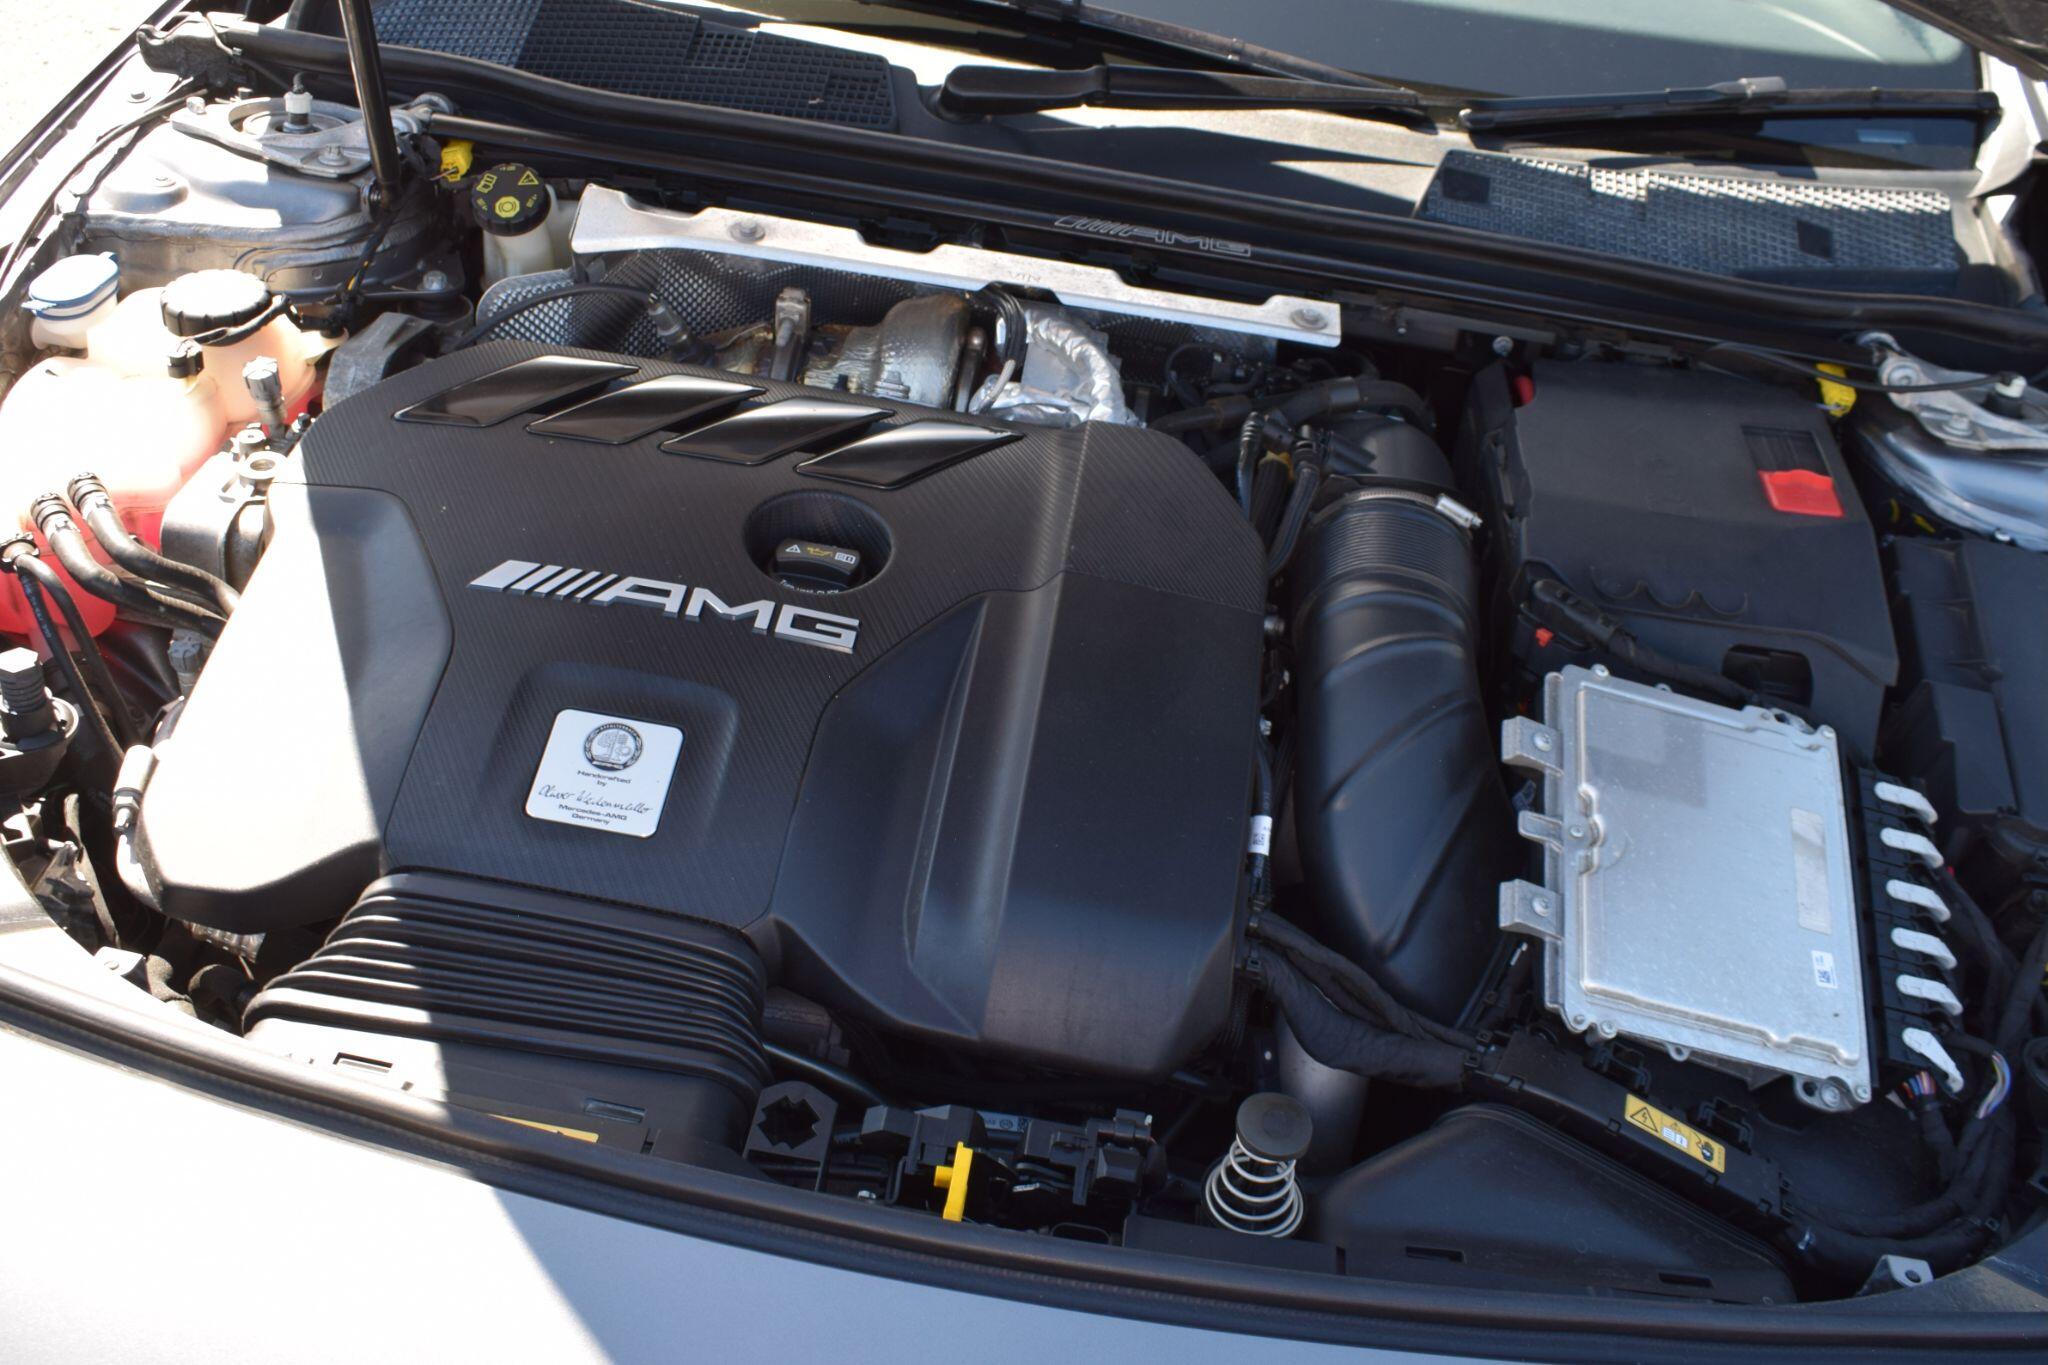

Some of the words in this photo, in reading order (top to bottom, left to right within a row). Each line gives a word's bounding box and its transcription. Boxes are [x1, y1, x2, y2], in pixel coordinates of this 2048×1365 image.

[592, 576, 860, 654] AMG
[577, 769, 632, 785] Handcrafted
[558, 803, 628, 821] Mercedes-AMG
[571, 813, 611, 825] Germany
